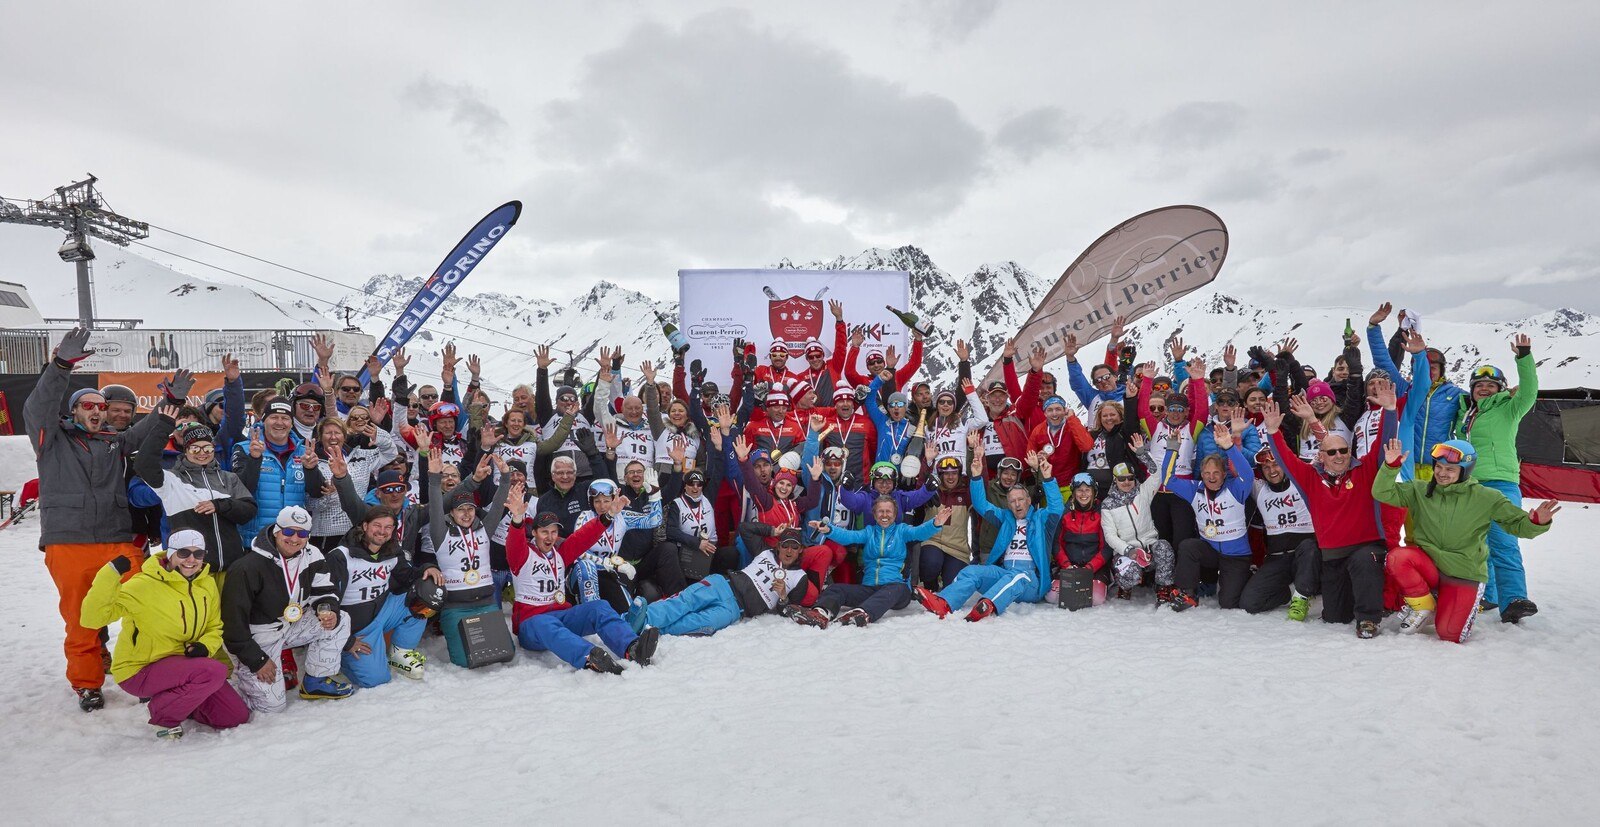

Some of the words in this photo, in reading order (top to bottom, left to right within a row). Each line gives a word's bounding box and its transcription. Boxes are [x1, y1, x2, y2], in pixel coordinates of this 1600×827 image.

[630, 443, 647, 455] 19
[1277, 511, 1298, 525] 85
[460, 555, 480, 572] 36
